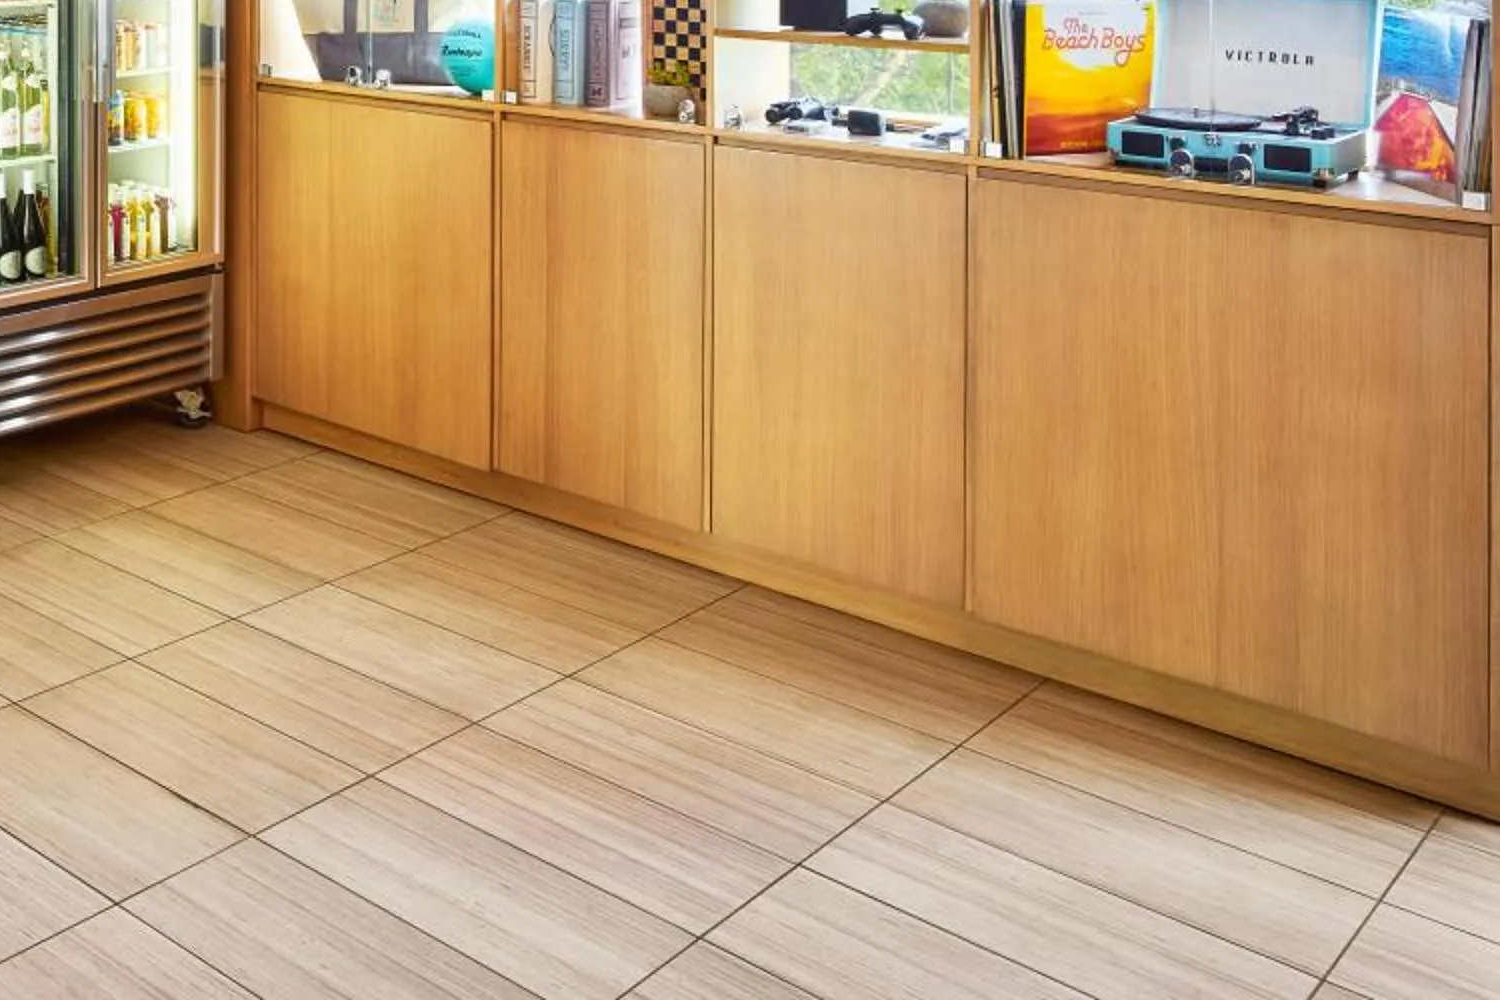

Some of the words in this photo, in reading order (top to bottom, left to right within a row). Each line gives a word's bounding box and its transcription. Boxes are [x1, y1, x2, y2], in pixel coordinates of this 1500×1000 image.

[1063, 16, 1090, 34] The
[1041, 27, 1099, 50] Beach
[1100, 26, 1146, 67] Boys
[1224, 49, 1315, 66] VICTROLA
